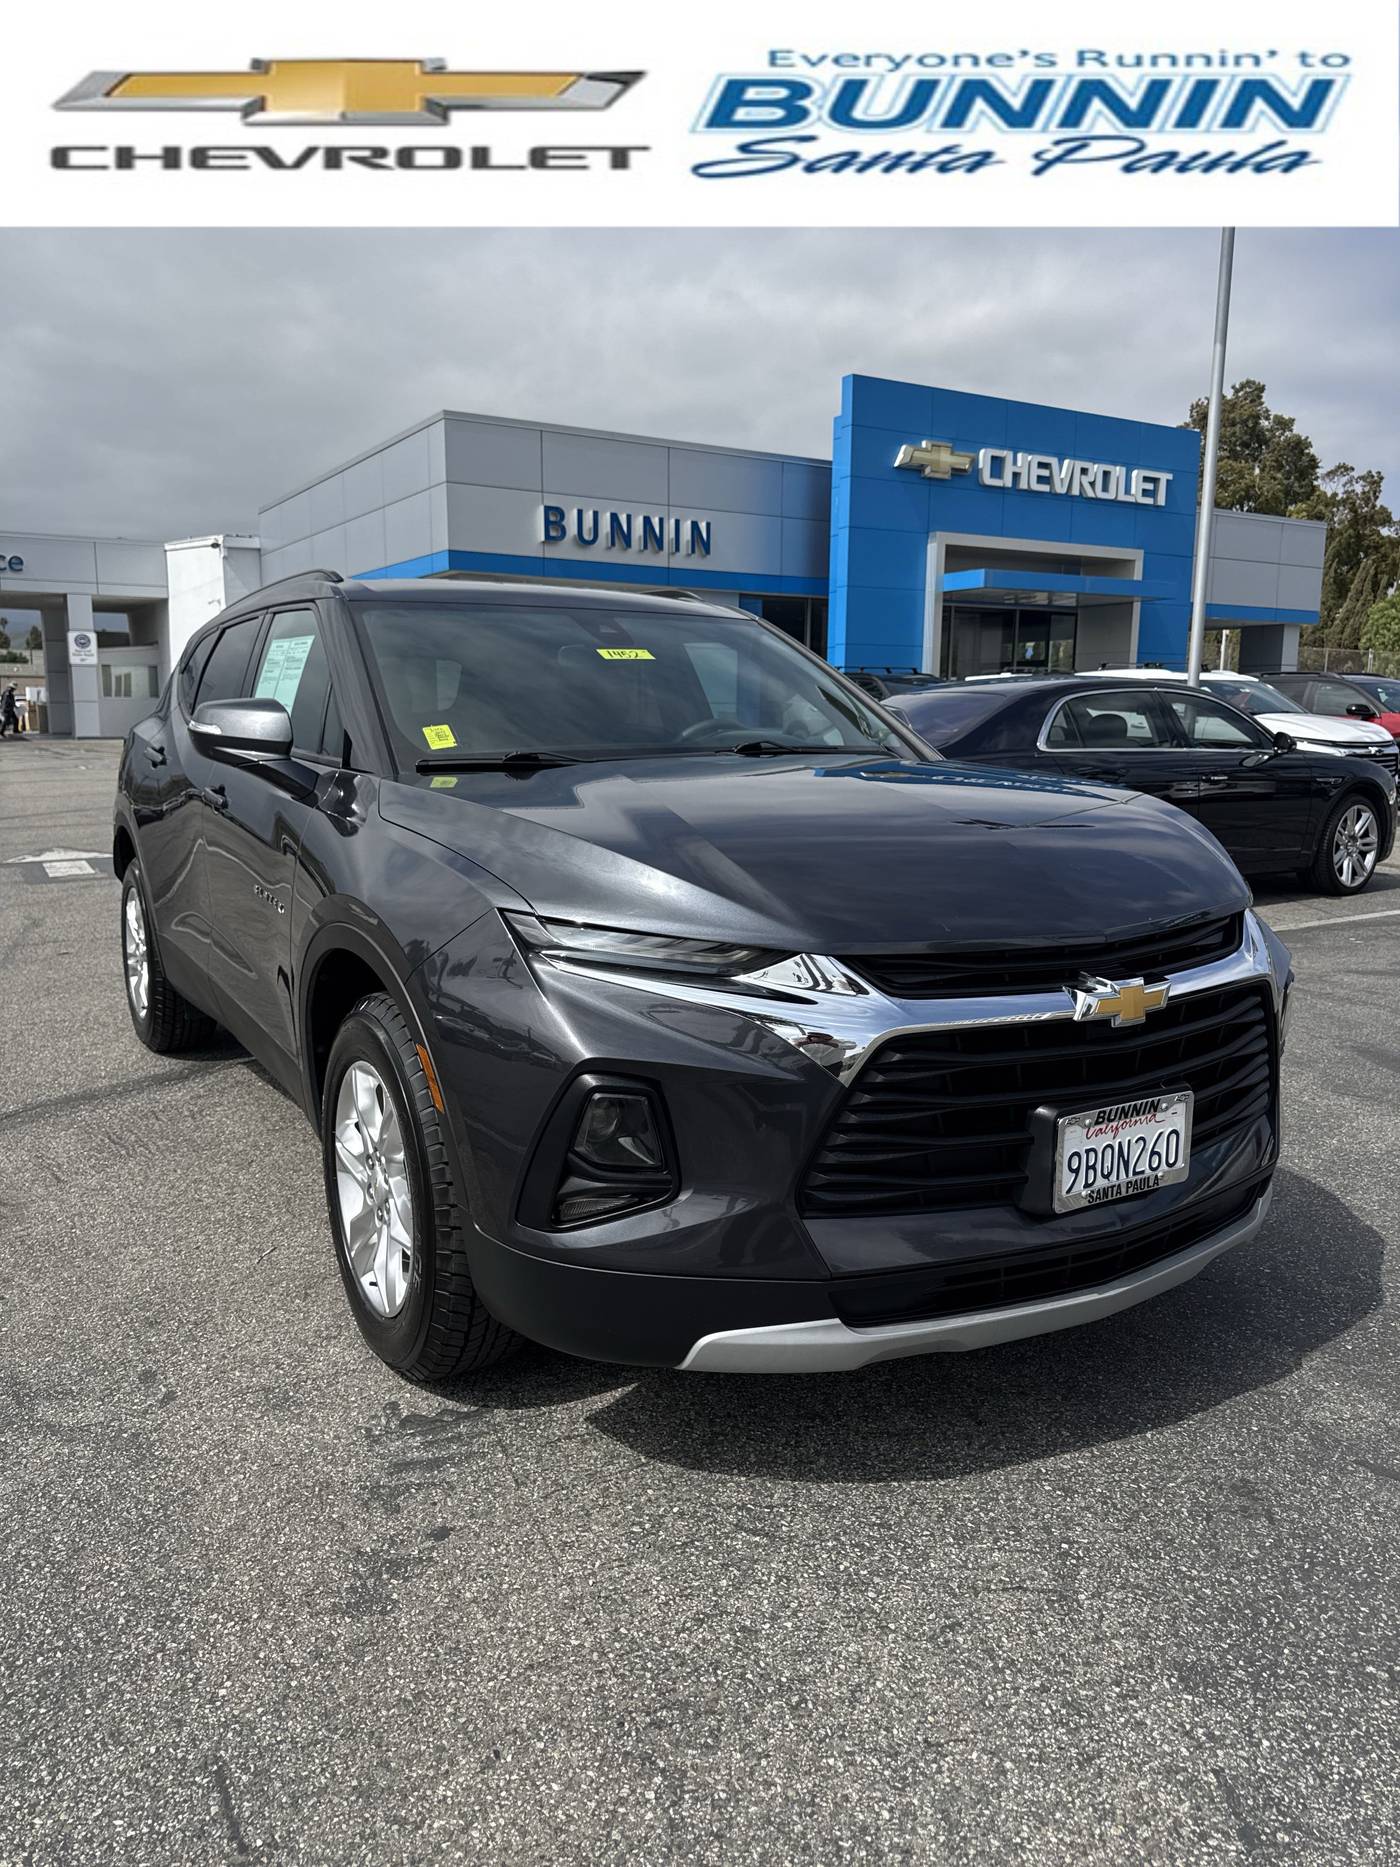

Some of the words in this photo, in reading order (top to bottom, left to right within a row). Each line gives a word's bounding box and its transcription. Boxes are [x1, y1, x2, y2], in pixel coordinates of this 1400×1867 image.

[978, 448, 1174, 507] CHEVROLET
[539, 504, 712, 556] BUNNIN
[1086, 1112, 1166, 1140] California
[1094, 1098, 1161, 1126] BUNNIN
[1065, 1128, 1180, 1195] 9BQN260
[1087, 1186, 1122, 1204] SANTA
[1125, 1174, 1160, 1194] PAULA
